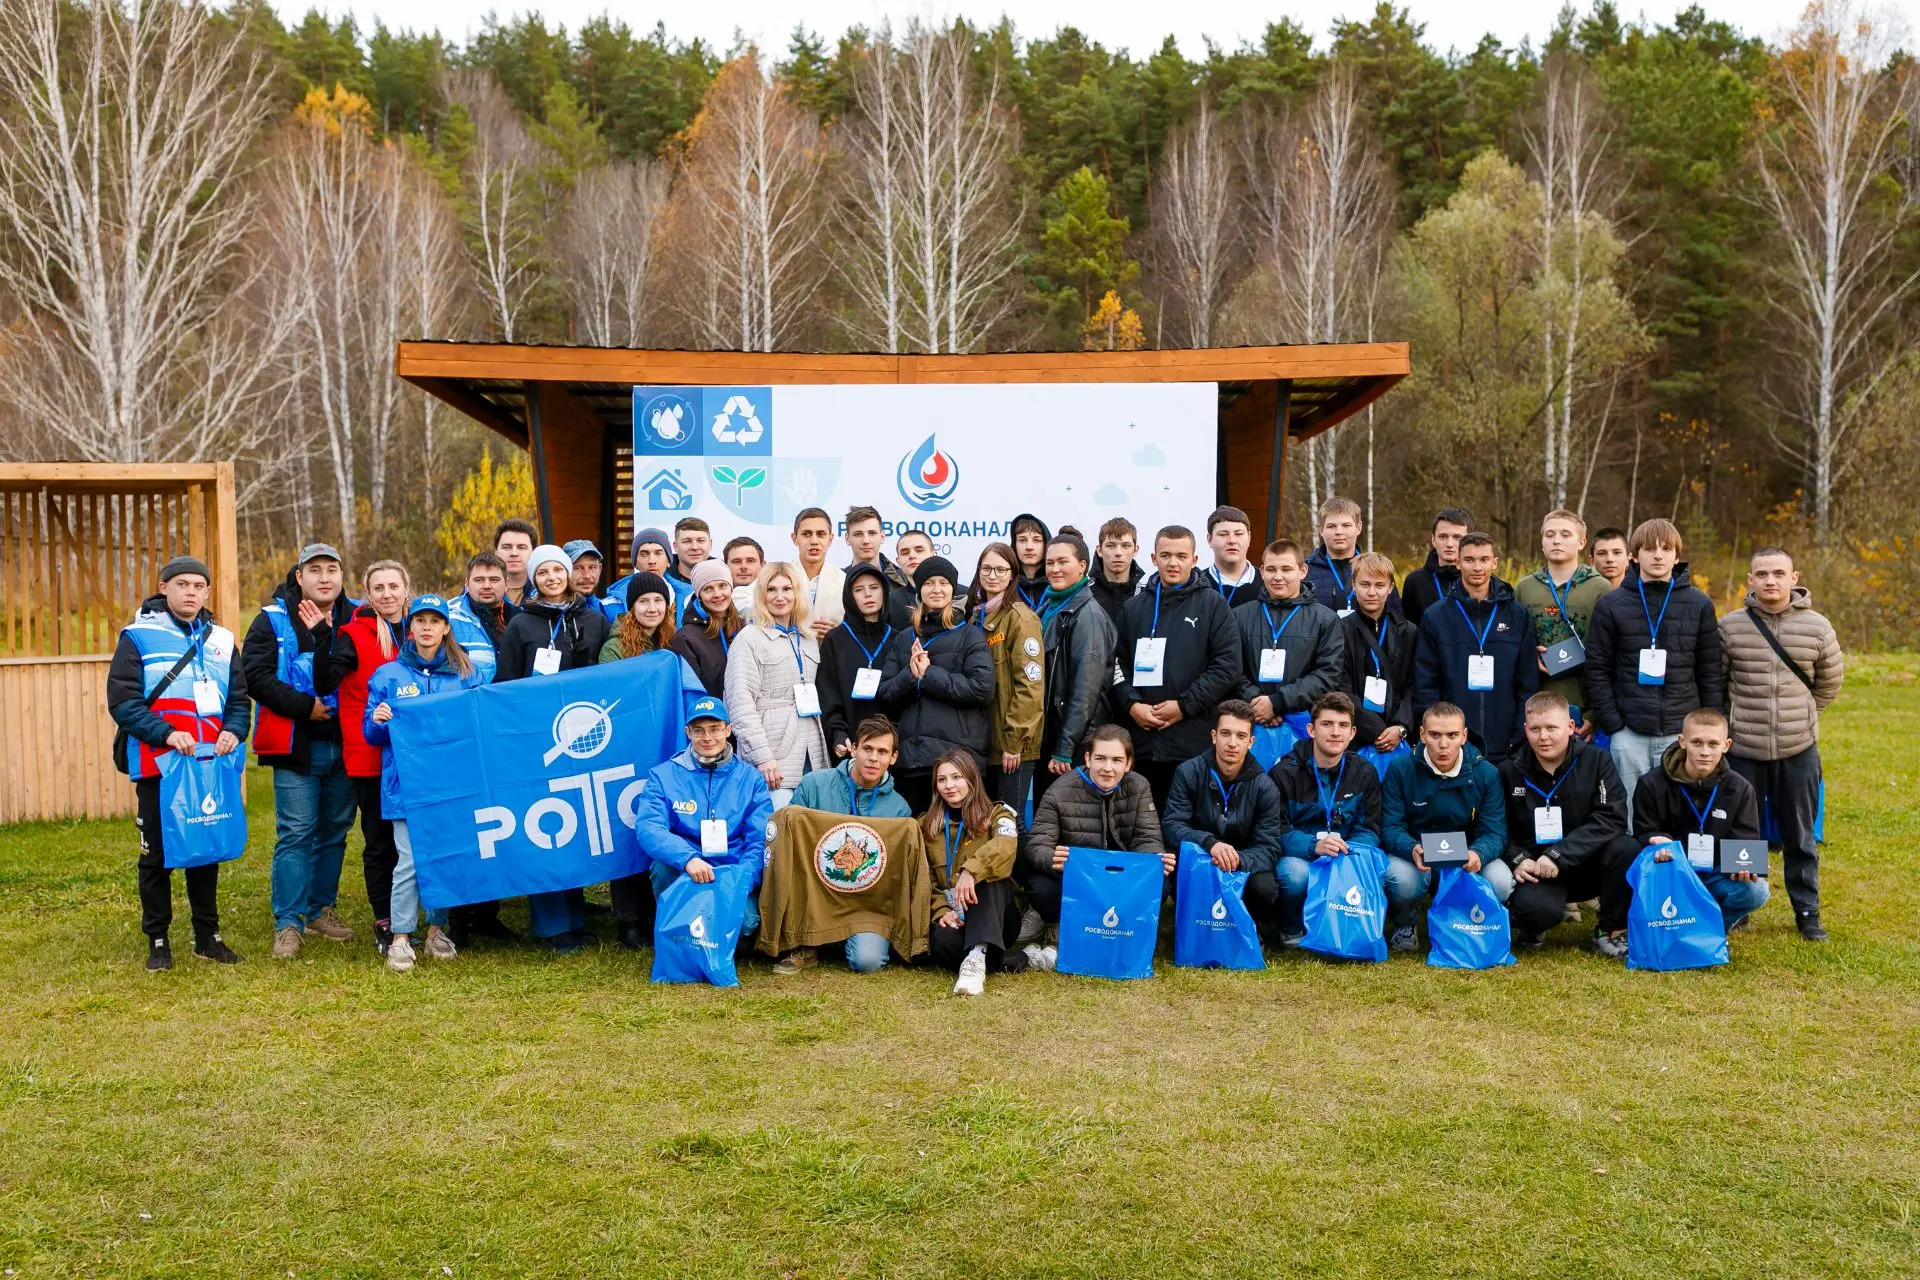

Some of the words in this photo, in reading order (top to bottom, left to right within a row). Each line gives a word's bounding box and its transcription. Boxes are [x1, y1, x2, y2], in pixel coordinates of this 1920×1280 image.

[838, 521, 1012, 537] РВОДОКАНАЛ
[857, 865, 878, 882] РЫСЬ
[1084, 926, 1135, 937] РОСВОДОКАНАЛ
